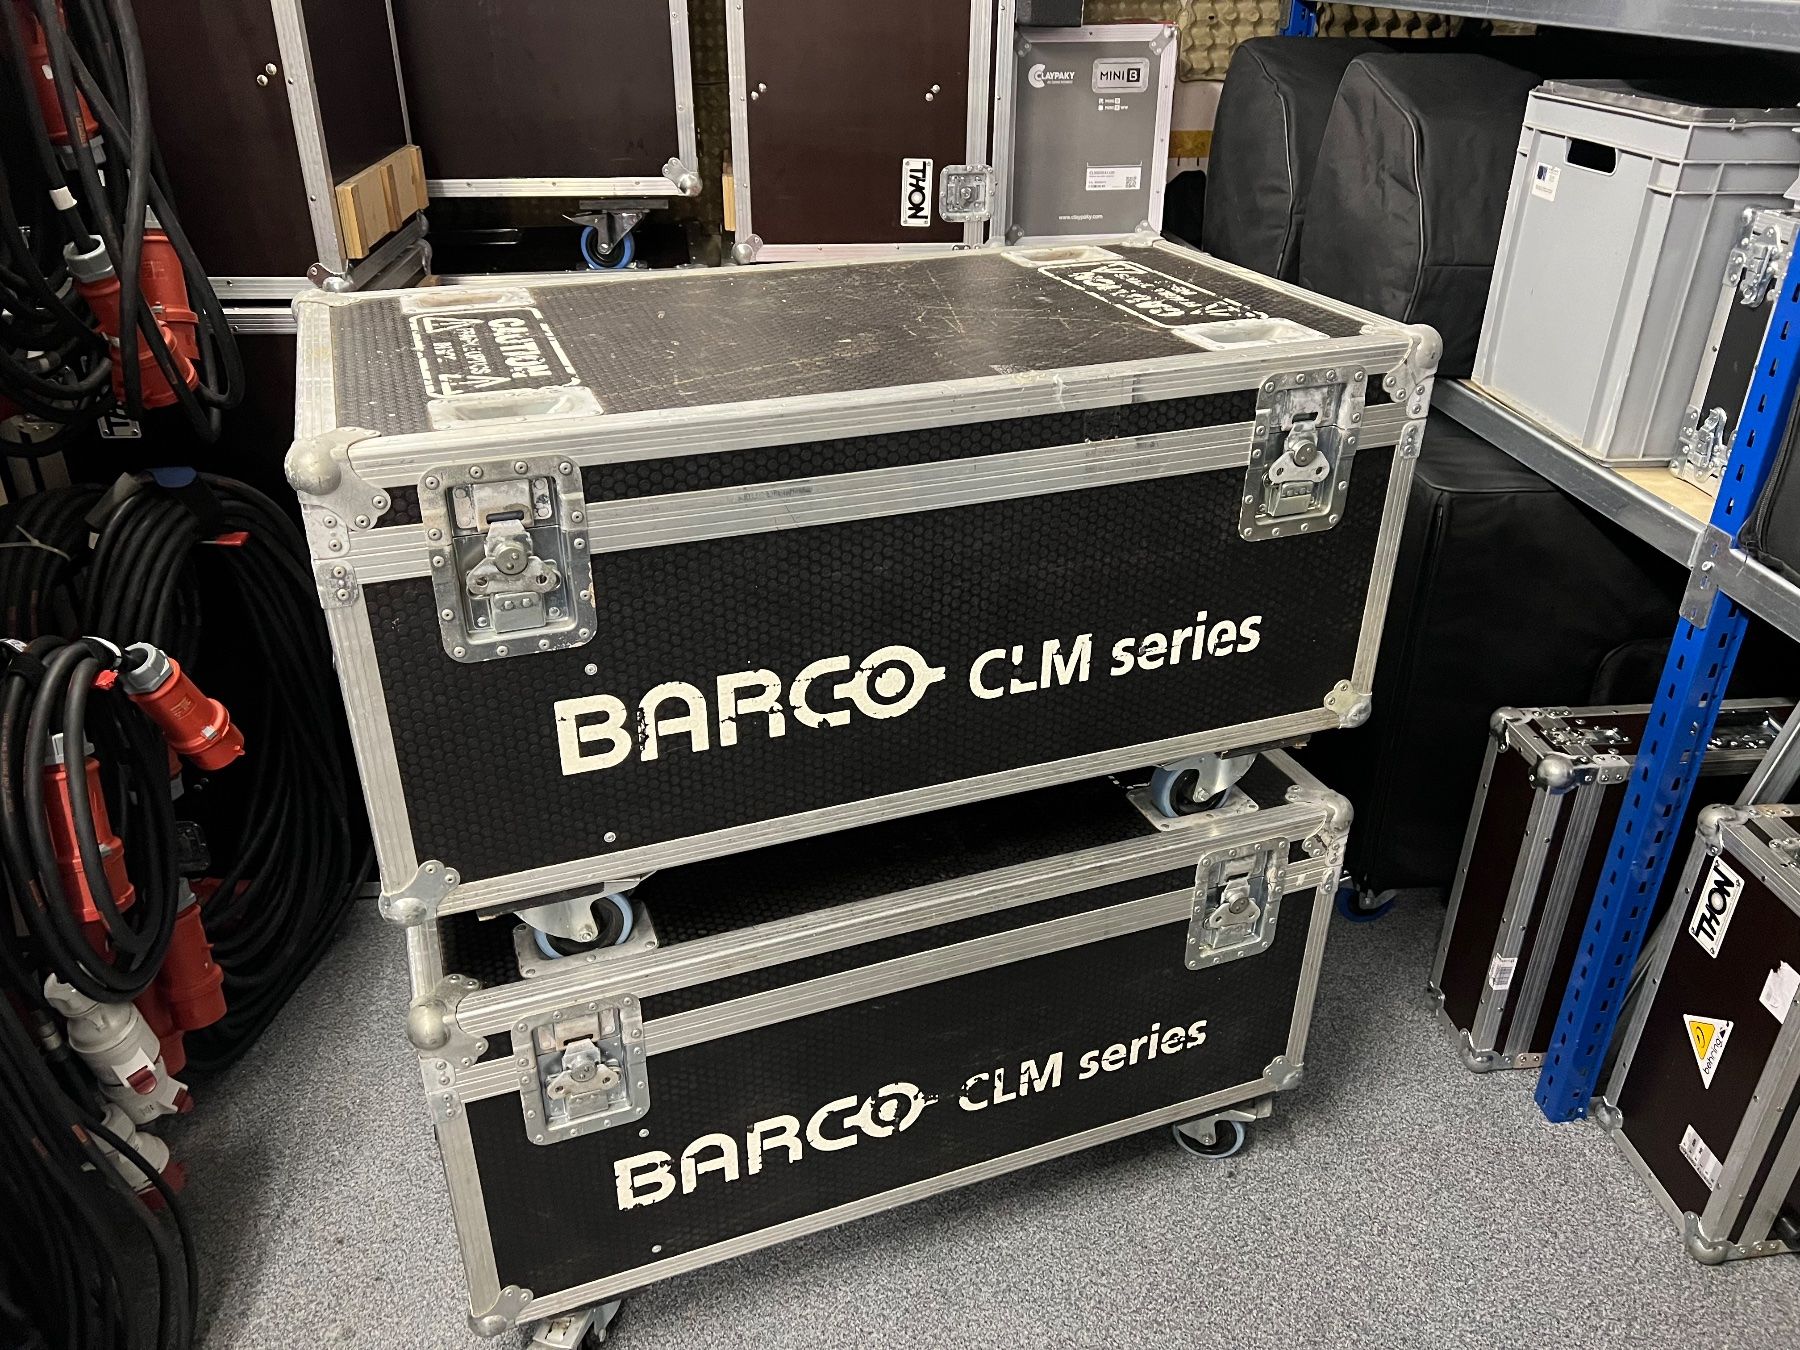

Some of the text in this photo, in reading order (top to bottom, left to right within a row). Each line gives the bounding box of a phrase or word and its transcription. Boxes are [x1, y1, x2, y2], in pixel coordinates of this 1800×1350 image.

[1100, 70, 1125, 80] MINI
[908, 161, 929, 219] THON
[553, 610, 1263, 776] BARCO CLM series
[1695, 866, 1735, 942] THON
[613, 1019, 1208, 1211] BARCO CLM series
